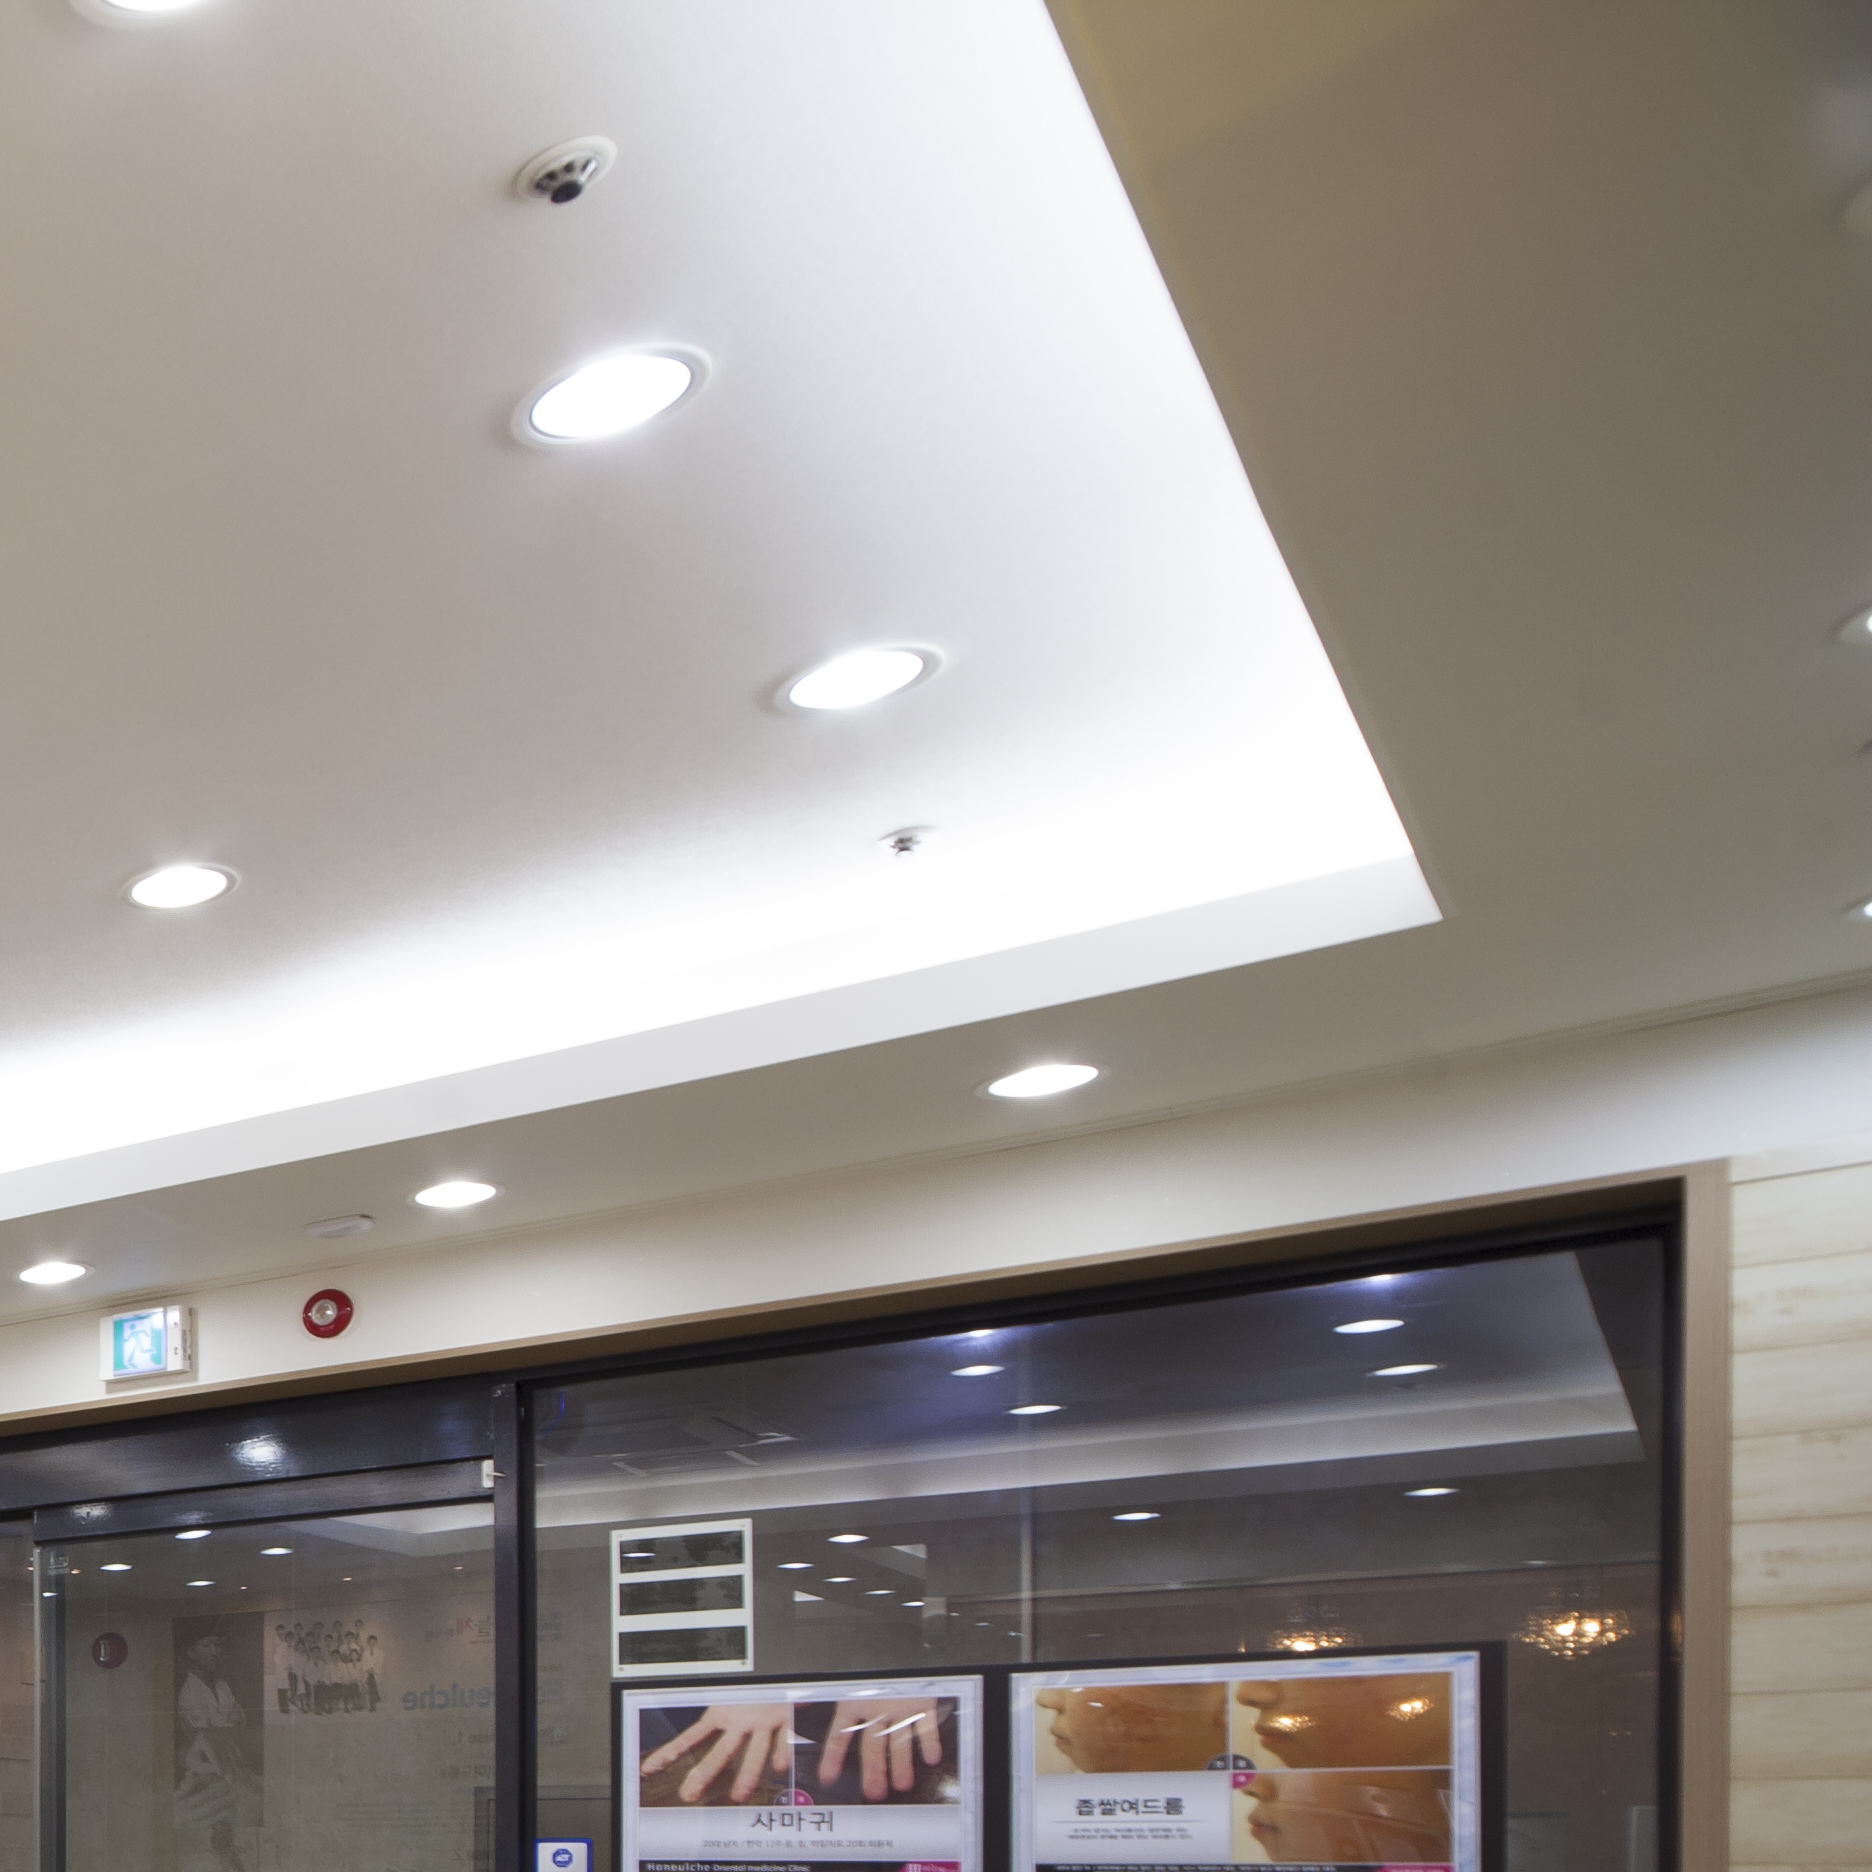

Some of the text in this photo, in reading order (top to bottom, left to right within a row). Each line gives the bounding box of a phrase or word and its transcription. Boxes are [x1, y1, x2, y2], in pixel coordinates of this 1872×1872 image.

[749, 1809, 837, 1834] 사마귀
[645, 1861, 711, 1872] Haneulche
[712, 1862, 747, 1872] Oriental
[748, 1863, 787, 1872] medicine
